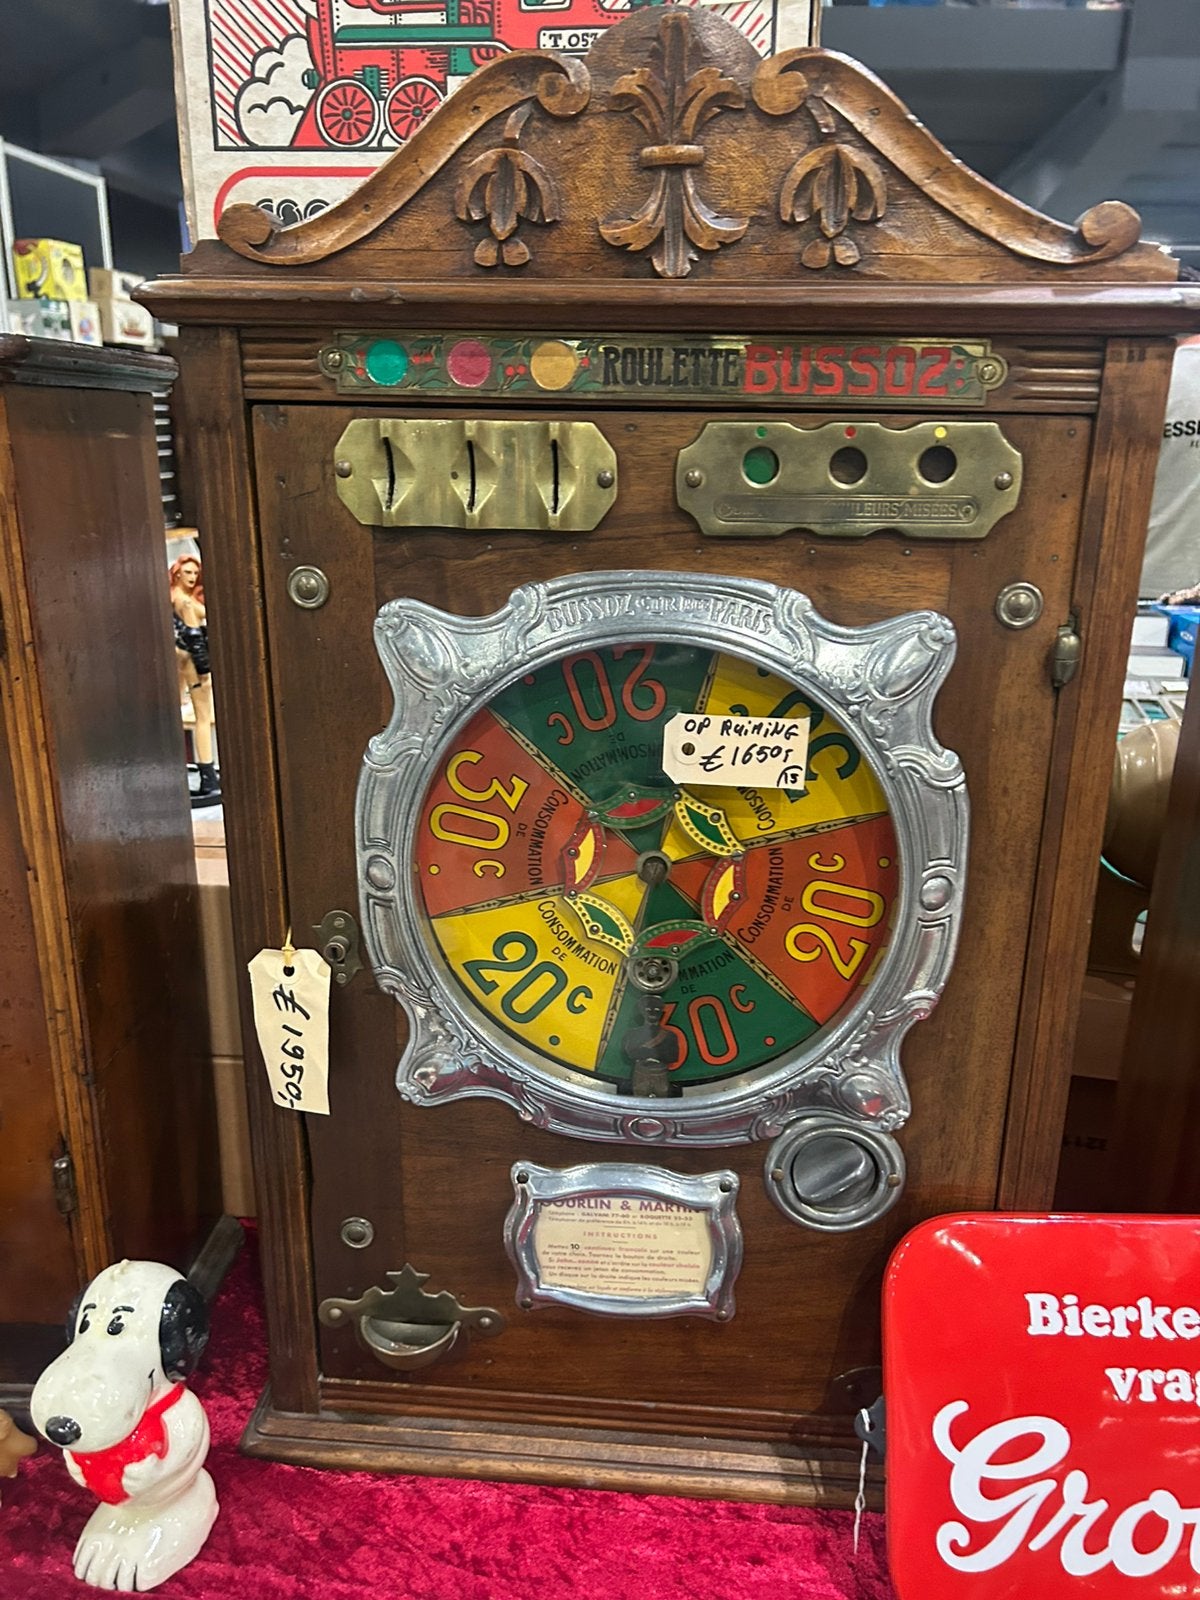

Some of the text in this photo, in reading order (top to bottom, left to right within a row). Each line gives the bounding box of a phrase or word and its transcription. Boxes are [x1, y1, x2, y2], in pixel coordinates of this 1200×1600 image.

[602, 344, 954, 396] ROULETTE BUSSOZ
[710, 599, 775, 635] PARIS
[684, 717, 711, 734] OP
[516, 822, 528, 838] DE
[528, 789, 569, 886] CONSOMMATION
[737, 847, 785, 945] CONSOMMATION
[781, 896, 795, 912] DE
[537, 900, 618, 976] CONSOMMATION
[551, 946, 566, 962] DE
[681, 984, 697, 995] DE
[620, 1200, 632, 1211] &
[583, 1231, 658, 1240] INSTRUCTIONS
[1105, 1367, 1200, 1408] vra
[932, 1400, 1200, 1577] Gro
